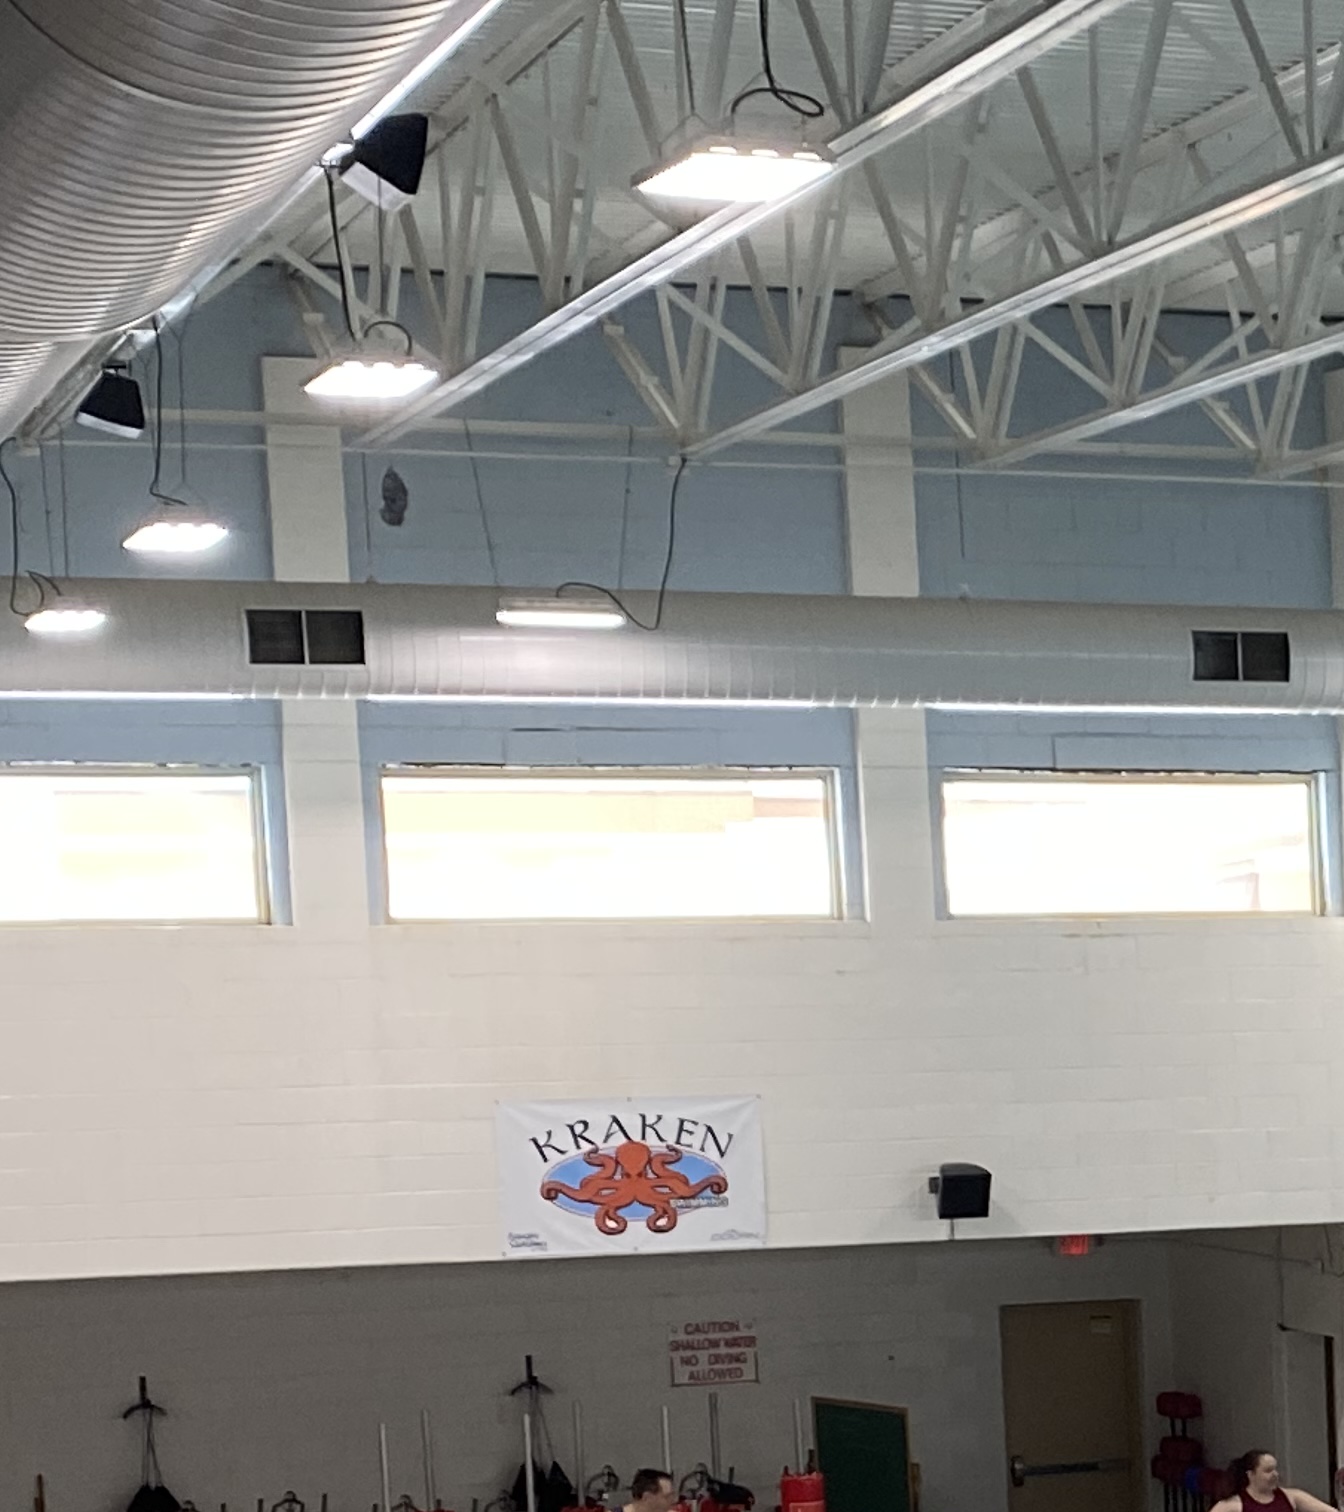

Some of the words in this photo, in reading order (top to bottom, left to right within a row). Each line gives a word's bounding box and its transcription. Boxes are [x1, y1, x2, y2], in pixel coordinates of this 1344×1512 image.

[529, 1113, 734, 1163] KRAKEN
[684, 1320, 740, 1335] CAUTION
[670, 1339, 721, 1352] SHALLOW
[724, 1336, 757, 1349] WATER
[680, 1355, 700, 1367] NO
[708, 1352, 747, 1366] DIVING
[688, 1367, 744, 1381] ALLOWED
